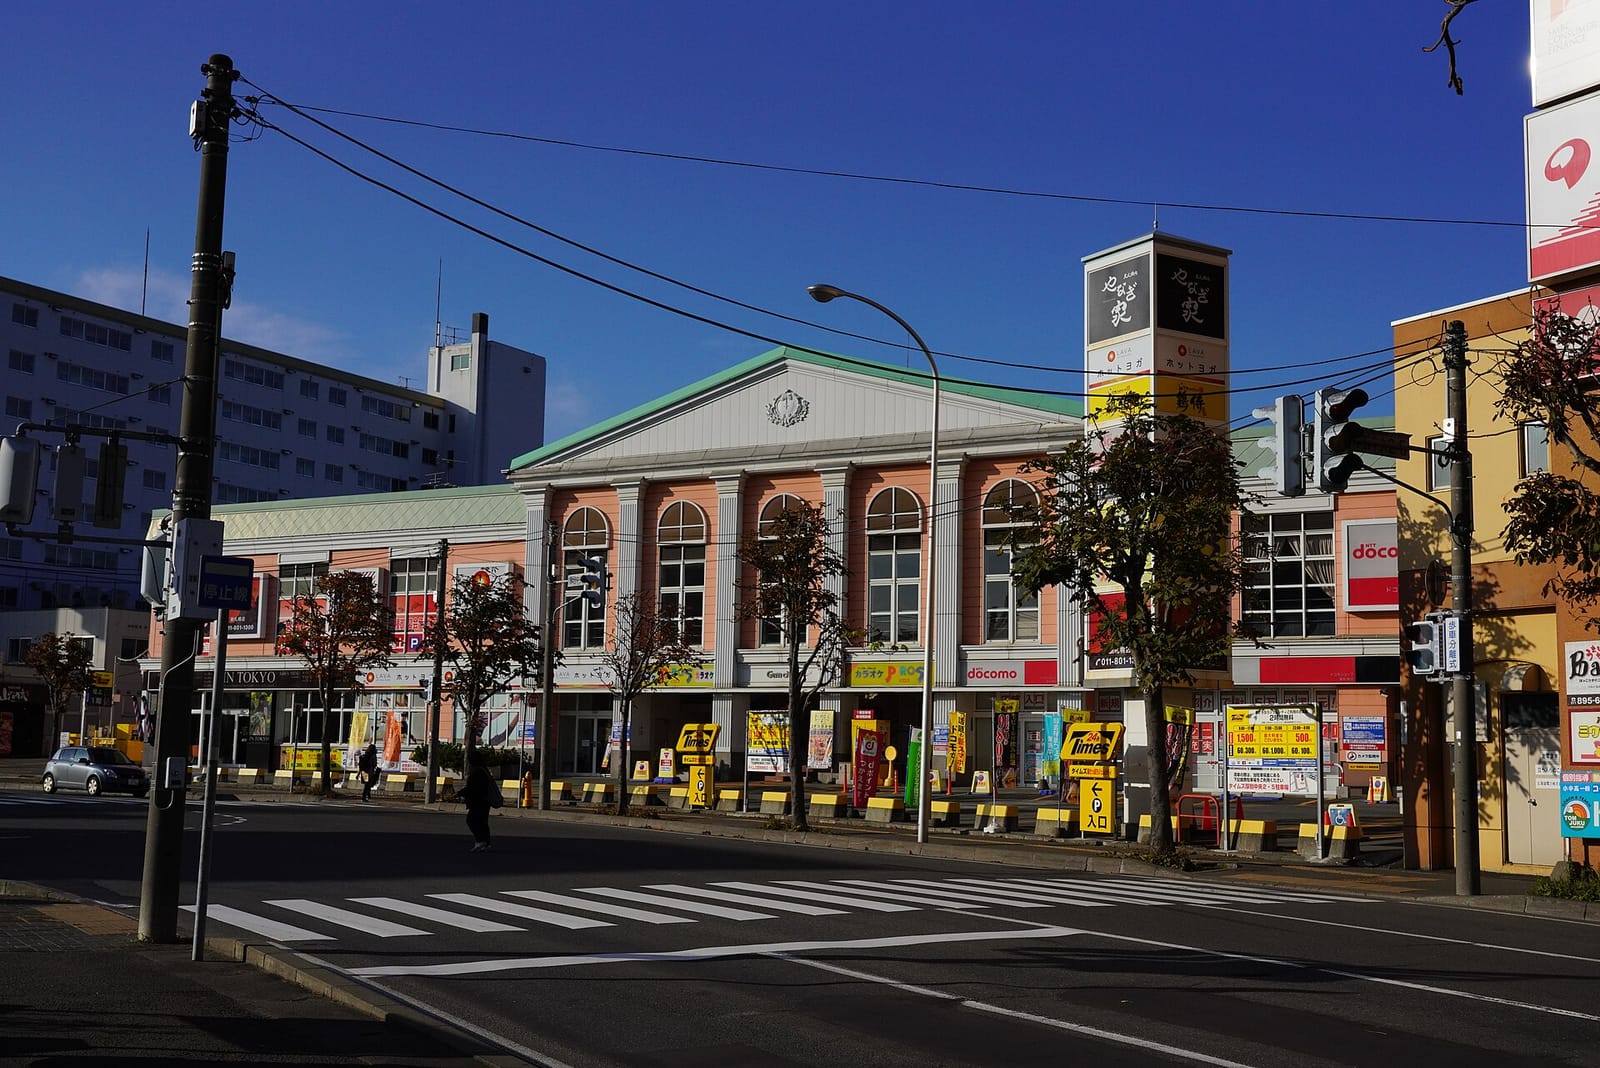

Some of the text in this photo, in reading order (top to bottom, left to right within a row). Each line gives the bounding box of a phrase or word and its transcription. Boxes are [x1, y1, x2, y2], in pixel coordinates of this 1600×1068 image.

[1166, 359, 1217, 373] ホットヨガ
[203, 583, 249, 602] 停止線
[237, 671, 277, 684] TOKYO
[855, 670, 884, 679] カラオケ
[968, 668, 1017, 679] docomo
[683, 735, 710, 748] Times
[1070, 739, 1110, 755] Times
[698, 781, 704, 789] P
[694, 793, 707, 803] 入口
[1094, 799, 1101, 811] P
[1087, 814, 1107, 829] 入口
